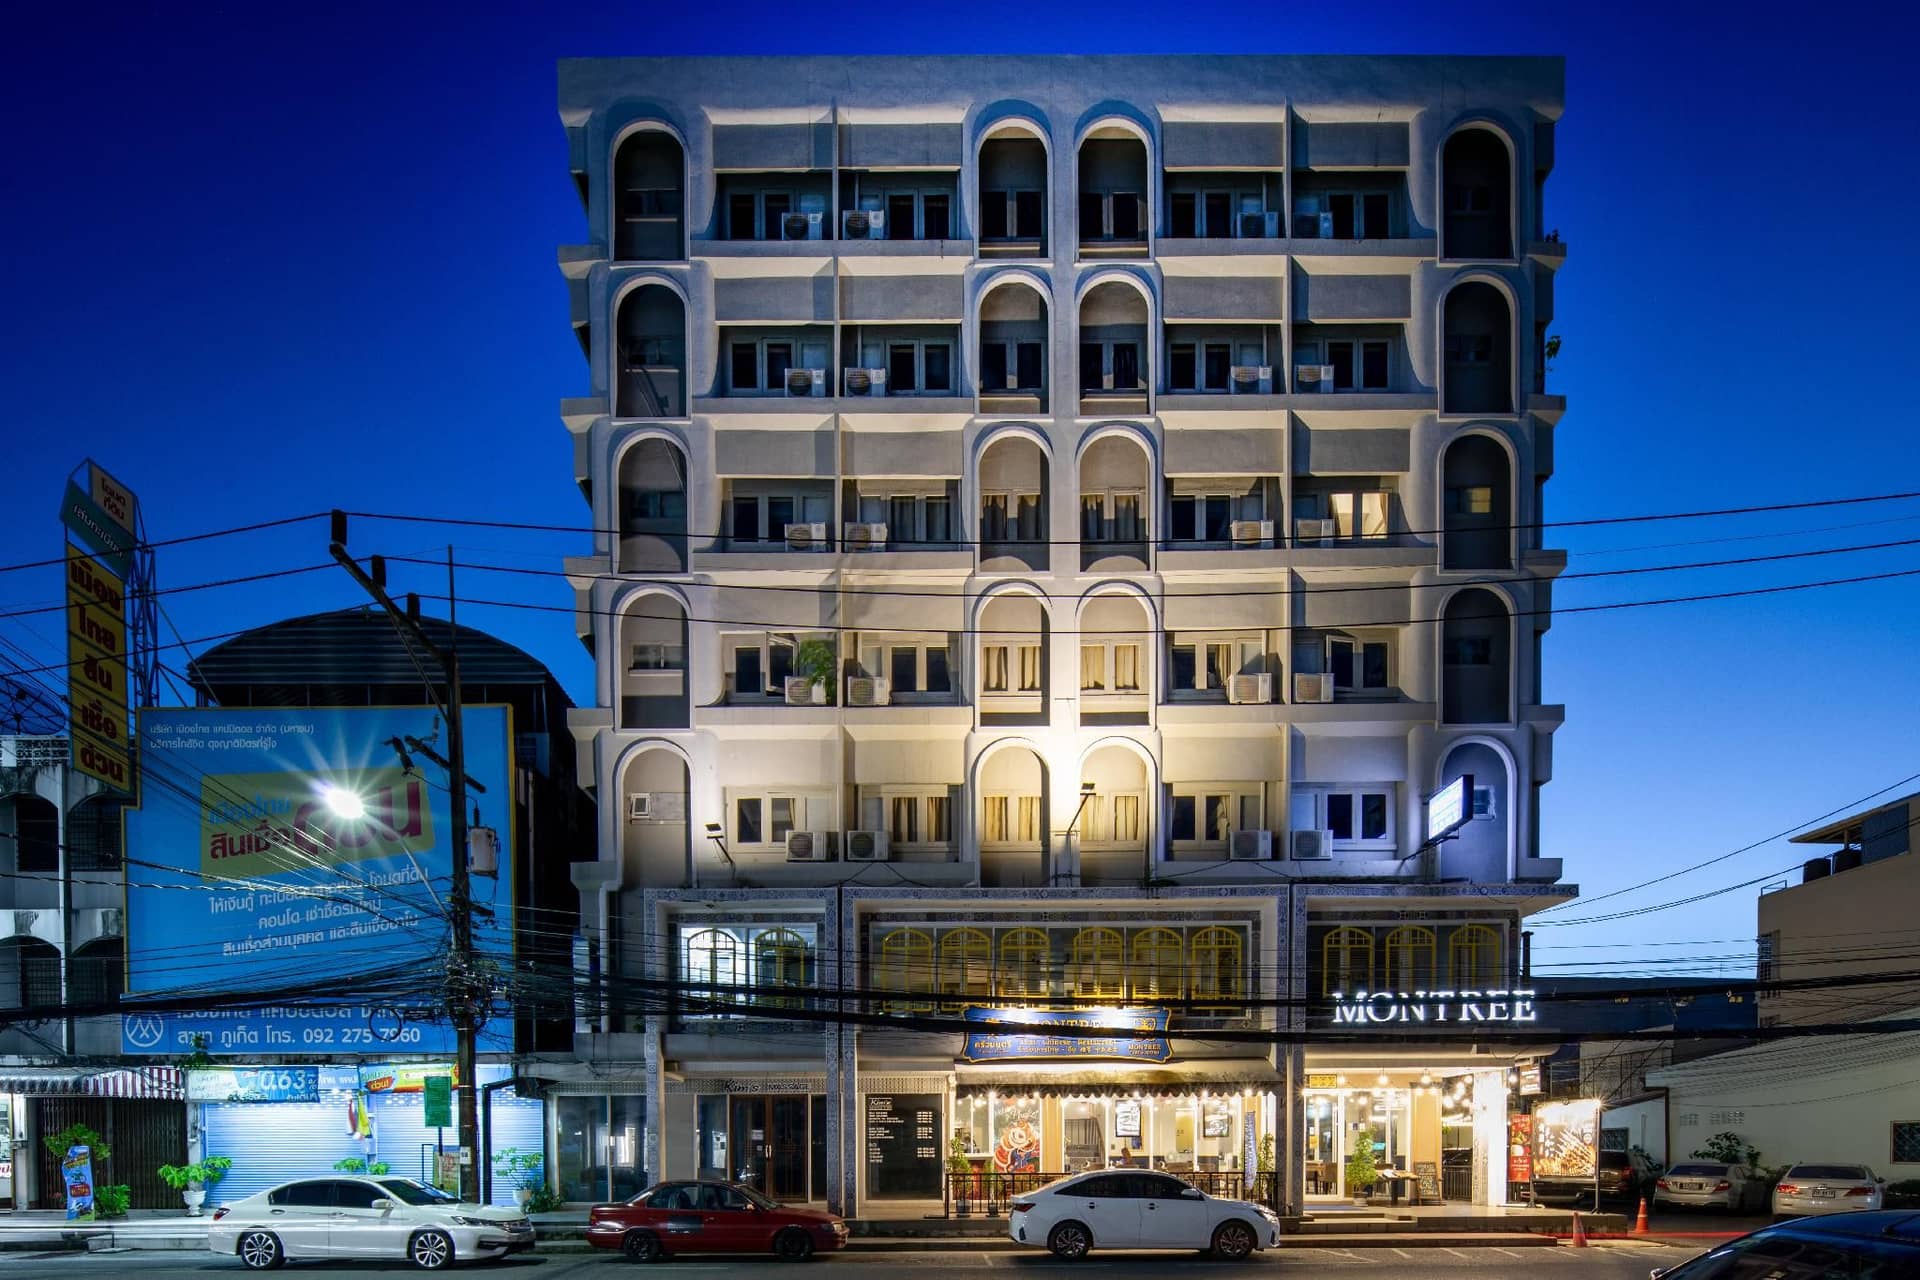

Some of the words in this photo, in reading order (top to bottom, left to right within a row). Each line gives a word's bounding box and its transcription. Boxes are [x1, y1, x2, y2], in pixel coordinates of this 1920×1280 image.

[1331, 990, 1536, 1022] MONTREE
[220, 1025, 258, 1048] ภูเก็ต
[266, 1025, 296, 1044] โทร.
[303, 1028, 334, 1043] 092
[342, 1028, 373, 1043] 275
[379, 1028, 421, 1043] 7960
[260, 1070, 305, 1090] 0.63
